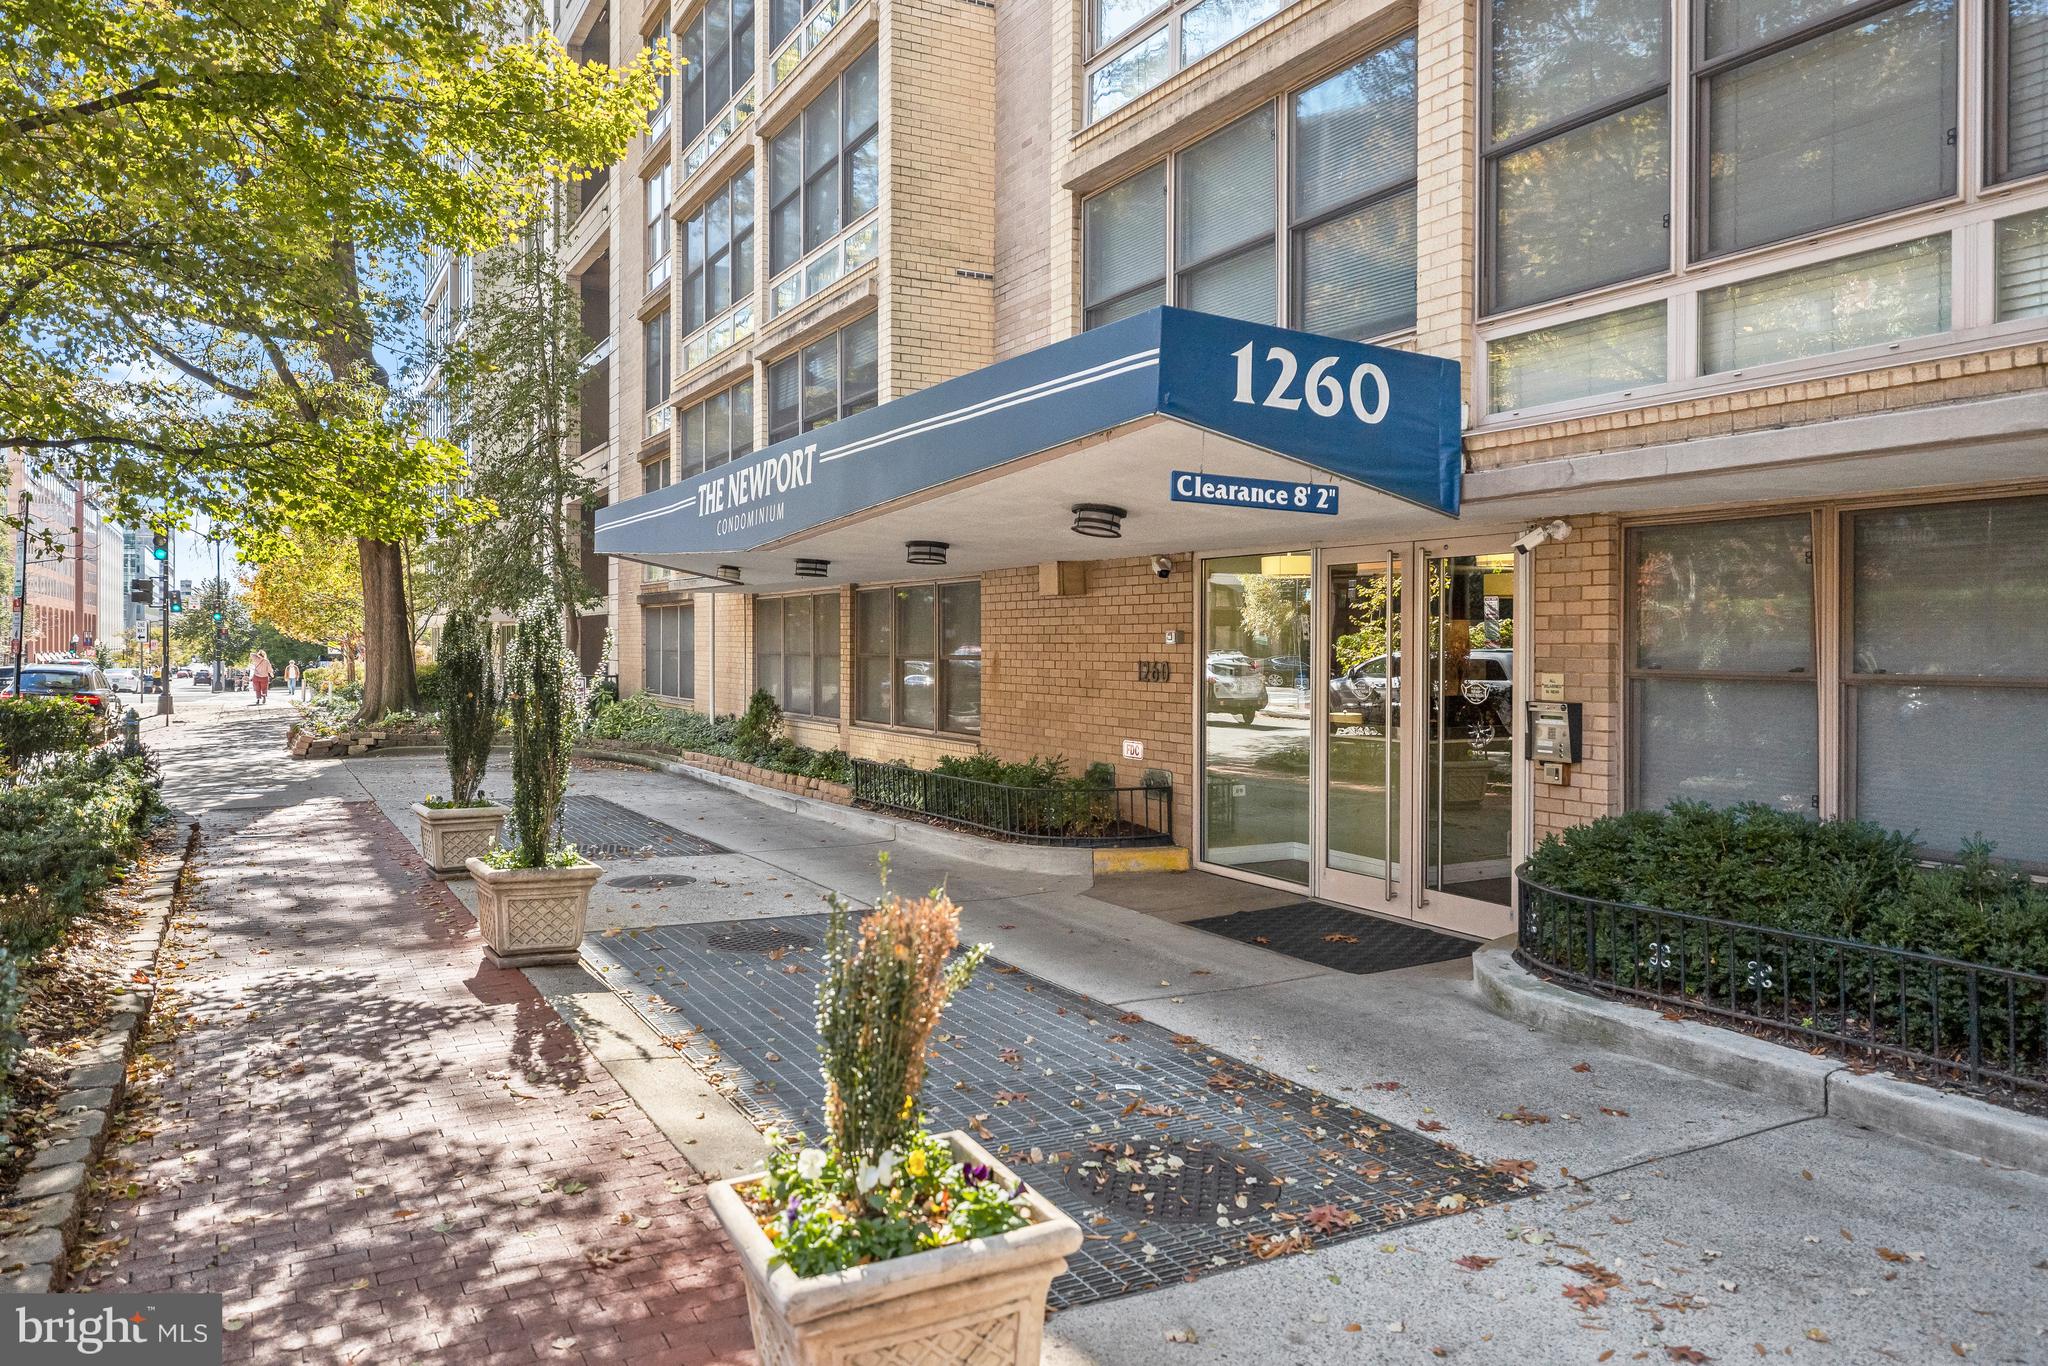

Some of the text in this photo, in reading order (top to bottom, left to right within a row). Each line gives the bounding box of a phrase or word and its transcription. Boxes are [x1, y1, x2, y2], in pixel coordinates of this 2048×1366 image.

[1231, 340, 1390, 424] 1260
[698, 443, 817, 517] THE NEWPORT
[1177, 475, 1336, 509] Clearance 8' 2"
[716, 502, 785, 536] CONDOMINIUM
[1138, 660, 1170, 683] 1260
[1126, 743, 1140, 757] FDC
